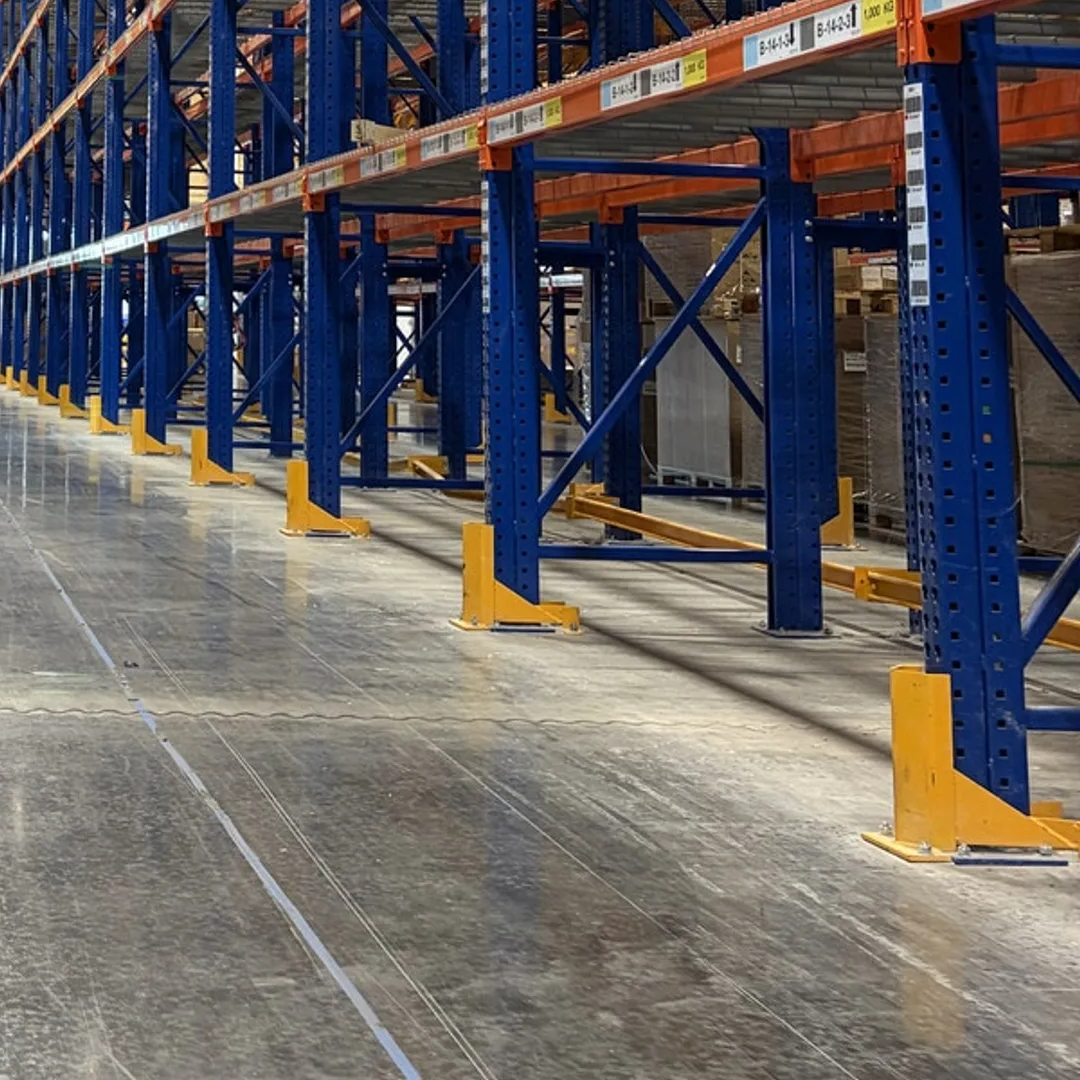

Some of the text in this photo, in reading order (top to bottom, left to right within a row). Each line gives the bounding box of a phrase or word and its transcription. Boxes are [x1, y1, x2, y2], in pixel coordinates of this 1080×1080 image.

[883, 0, 894, 14] KG
[817, 14, 851, 38] B-14-2-3
[759, 33, 790, 56] B-14-1-3
